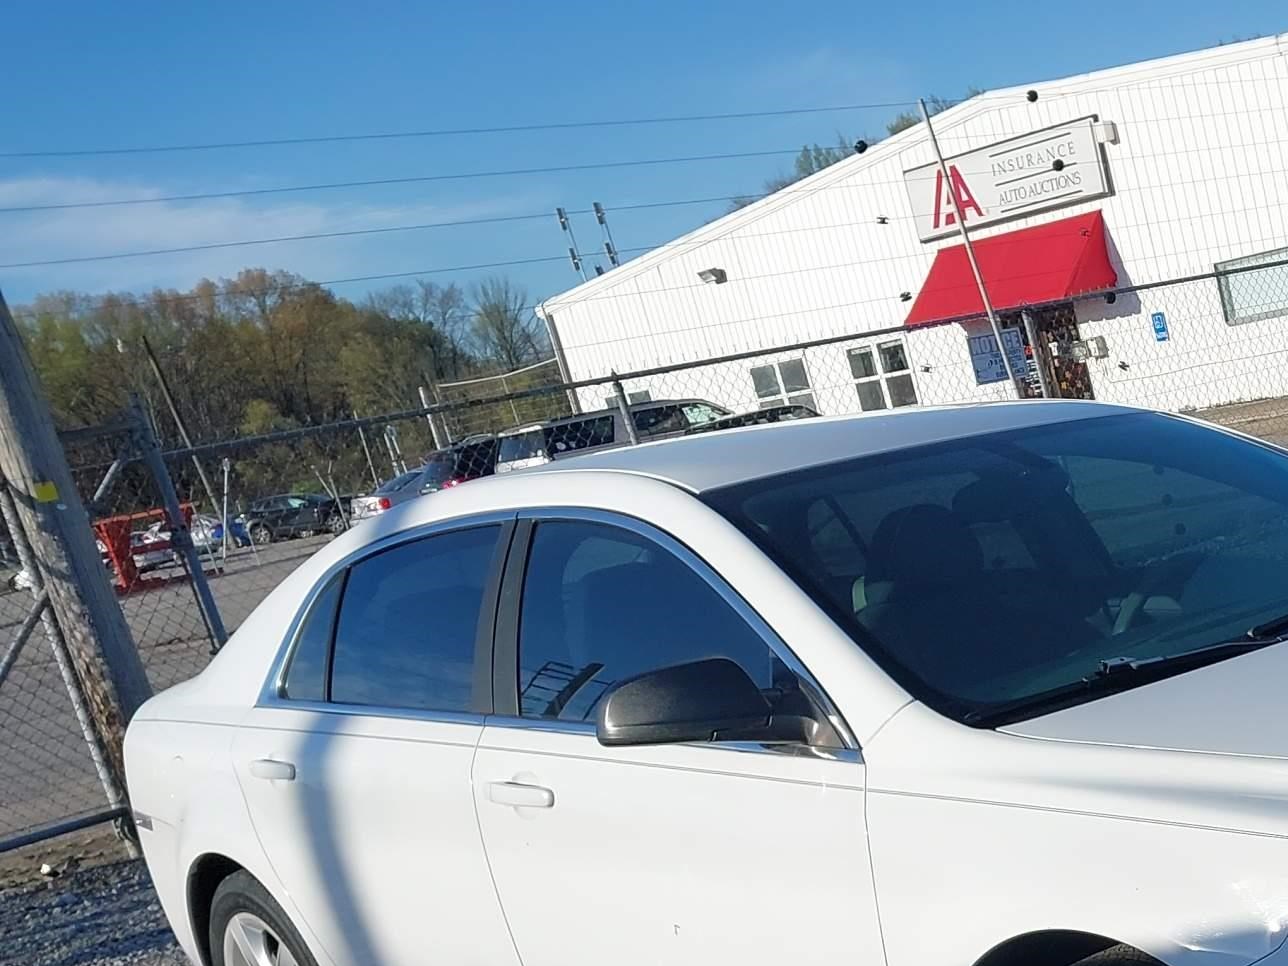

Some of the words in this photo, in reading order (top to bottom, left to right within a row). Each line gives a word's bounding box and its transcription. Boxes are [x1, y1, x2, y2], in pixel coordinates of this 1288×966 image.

[991, 141, 1076, 176] INSURANCE
[1000, 186, 1027, 207] AUTO
[1028, 171, 1082, 200] AUCTIONS
[970, 331, 1020, 355] NOTCE
